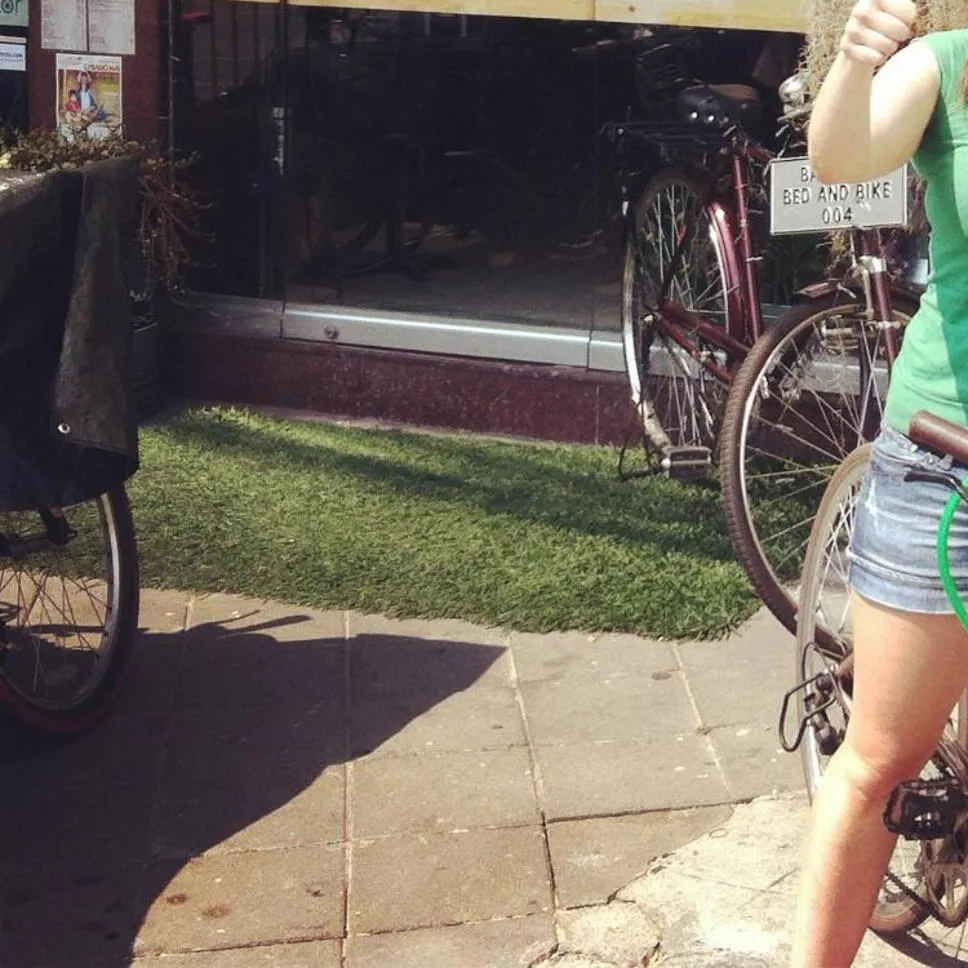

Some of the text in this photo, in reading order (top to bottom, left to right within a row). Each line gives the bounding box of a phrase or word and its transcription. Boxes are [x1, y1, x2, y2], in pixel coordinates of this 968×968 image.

[783, 181, 893, 206] BED AND BIKE
[822, 207, 853, 225] 004
